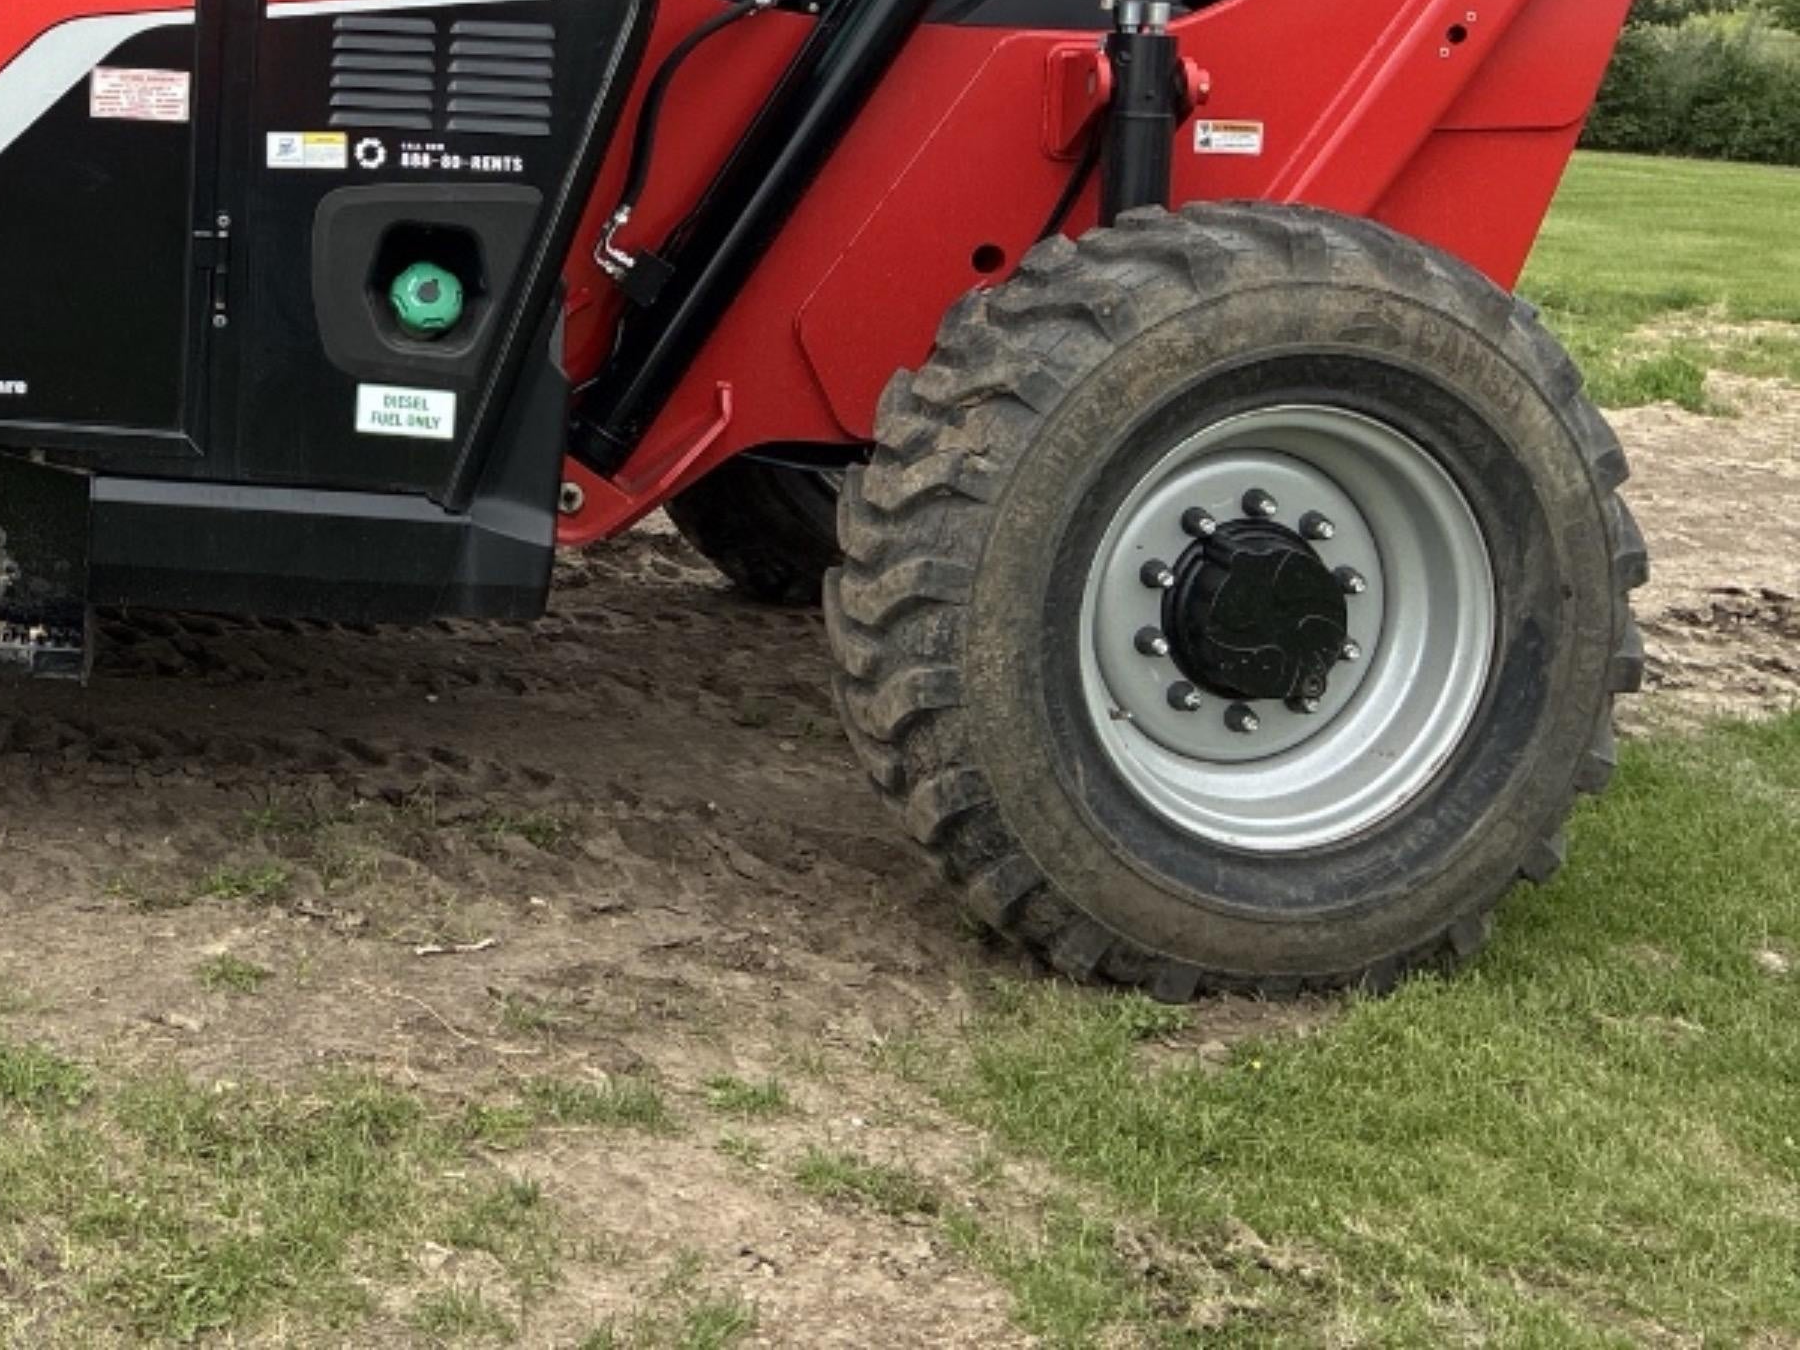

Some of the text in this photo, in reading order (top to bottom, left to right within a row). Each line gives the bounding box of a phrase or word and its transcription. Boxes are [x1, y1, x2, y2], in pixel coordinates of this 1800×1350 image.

[383, 394, 429, 412] DIESEL
[370, 410, 441, 430] FUEL ONLY
